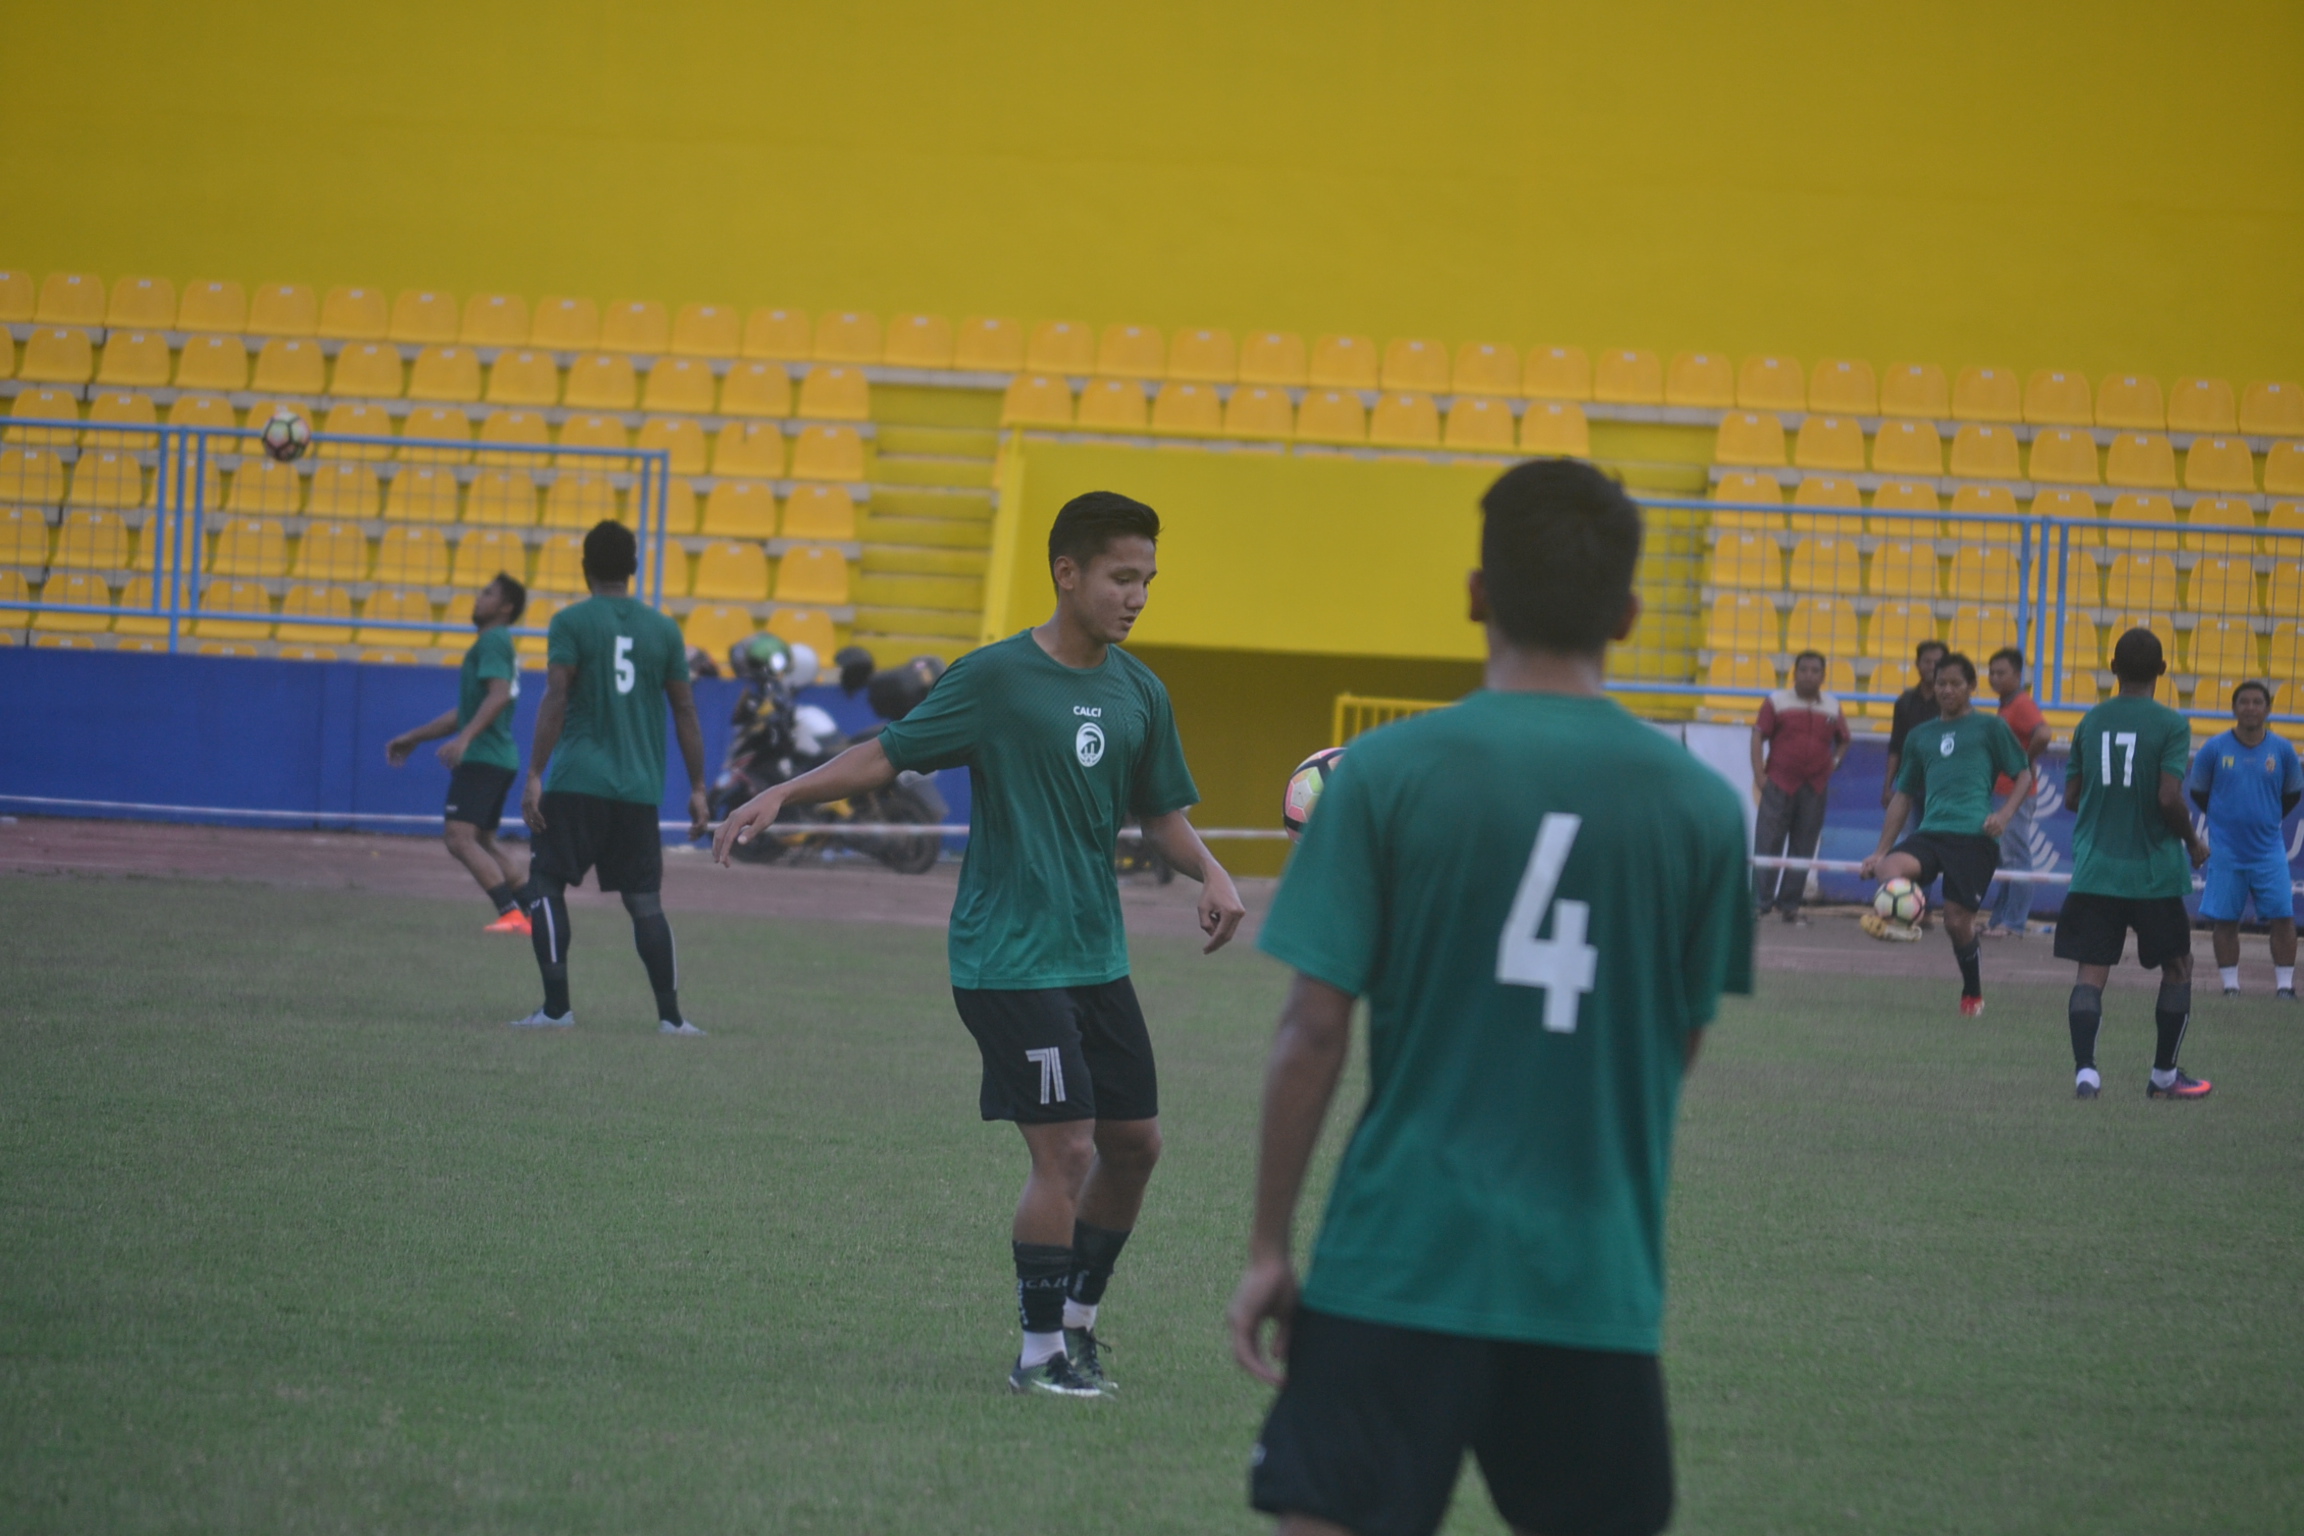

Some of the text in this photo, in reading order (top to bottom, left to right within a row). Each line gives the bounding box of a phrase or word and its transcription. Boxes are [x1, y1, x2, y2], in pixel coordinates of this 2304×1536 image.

[614, 635, 635, 694] 5
[1073, 706, 1102, 717] CALCI
[2101, 731, 2137, 787] 17
[1496, 811, 1598, 1034] 4
